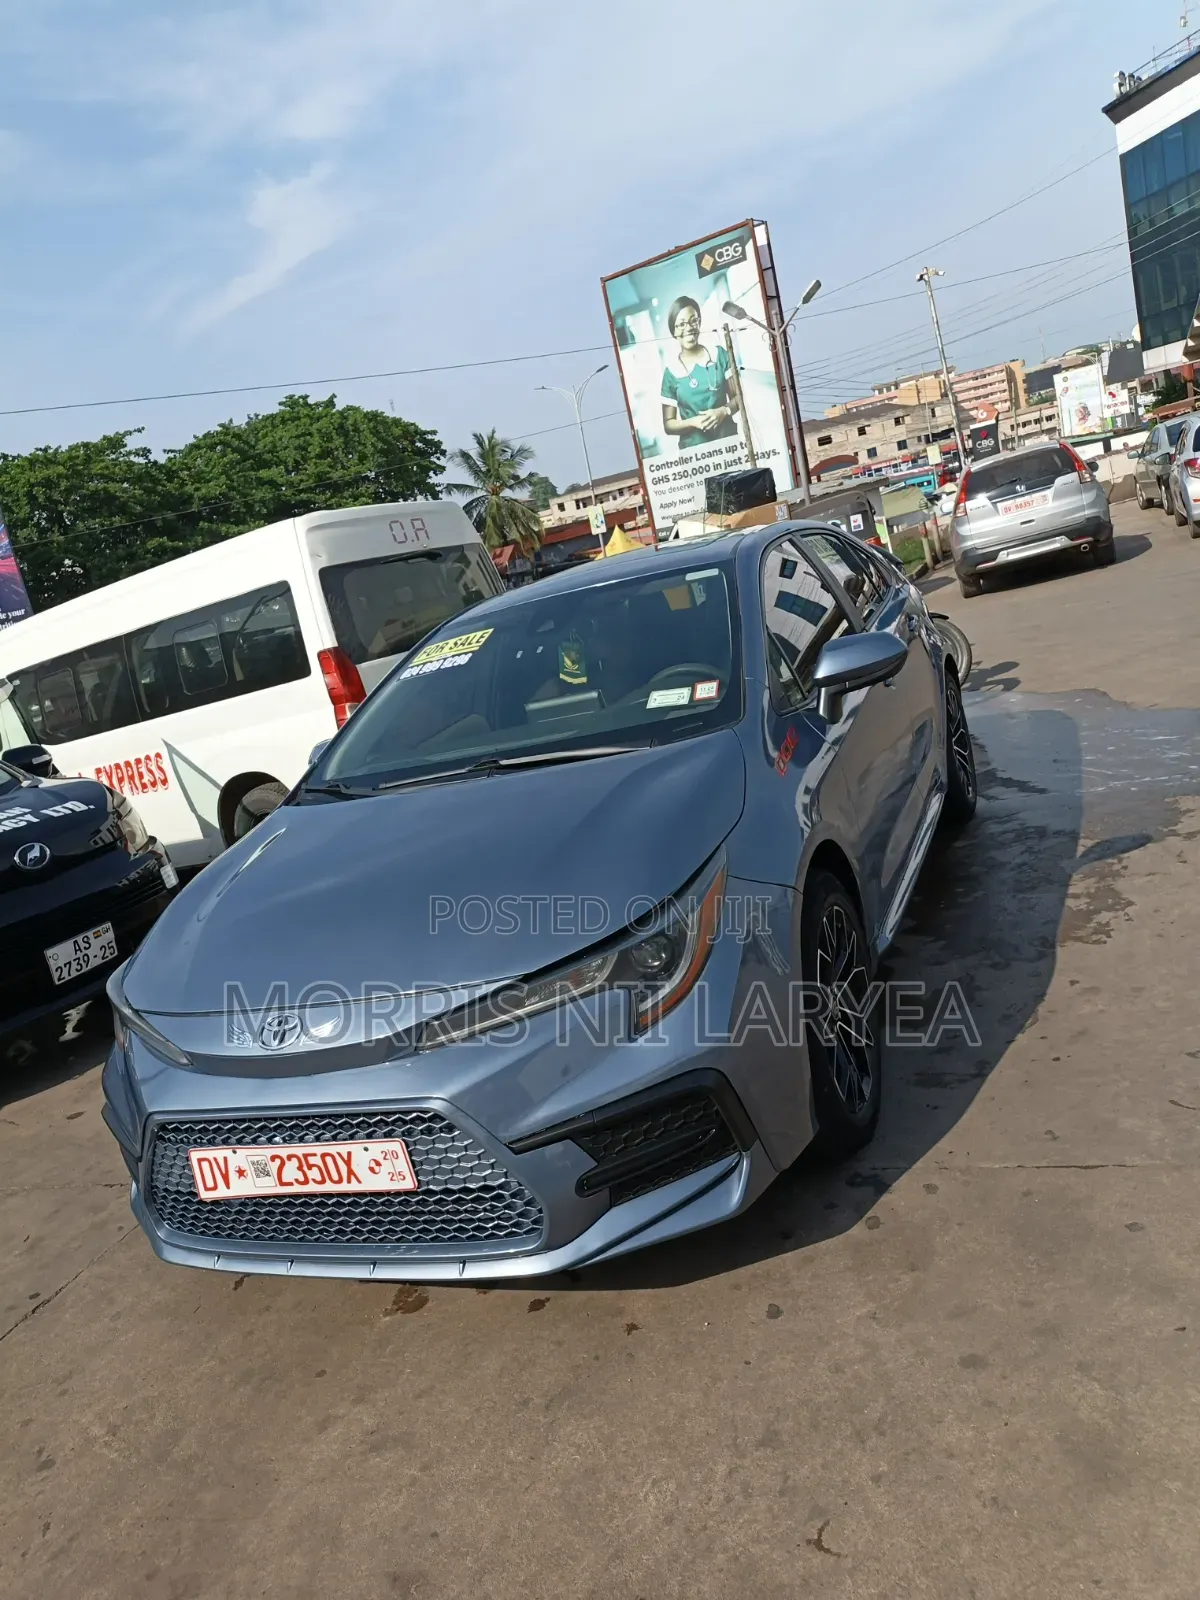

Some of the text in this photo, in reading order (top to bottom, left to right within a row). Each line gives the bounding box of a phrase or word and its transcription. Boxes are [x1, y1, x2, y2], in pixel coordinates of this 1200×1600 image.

[715, 242, 742, 262] CBG
[976, 438, 994, 448] CBG
[649, 454, 693, 473] Controller
[694, 446, 723, 462] Loans
[725, 442, 738, 455] up
[651, 472, 671, 486] GHS
[672, 464, 711, 480] 250,000
[712, 461, 722, 472] in
[723, 456, 743, 471] just
[754, 448, 781, 461] days.
[653, 480, 704, 497] You deserve to
[659, 495, 695, 510] Apply Now!
[8, 608, 26, 619] your
[417, 632, 489, 660] FOR SALE
[94, 752, 169, 796] EXPRESS
[40, 800, 96, 818] LTD.
[73, 925, 111, 956] AS GH
[55, 941, 116, 982] 2739-25
[197, 1156, 231, 1192] DV
[270, 1151, 362, 1187] 2350X
